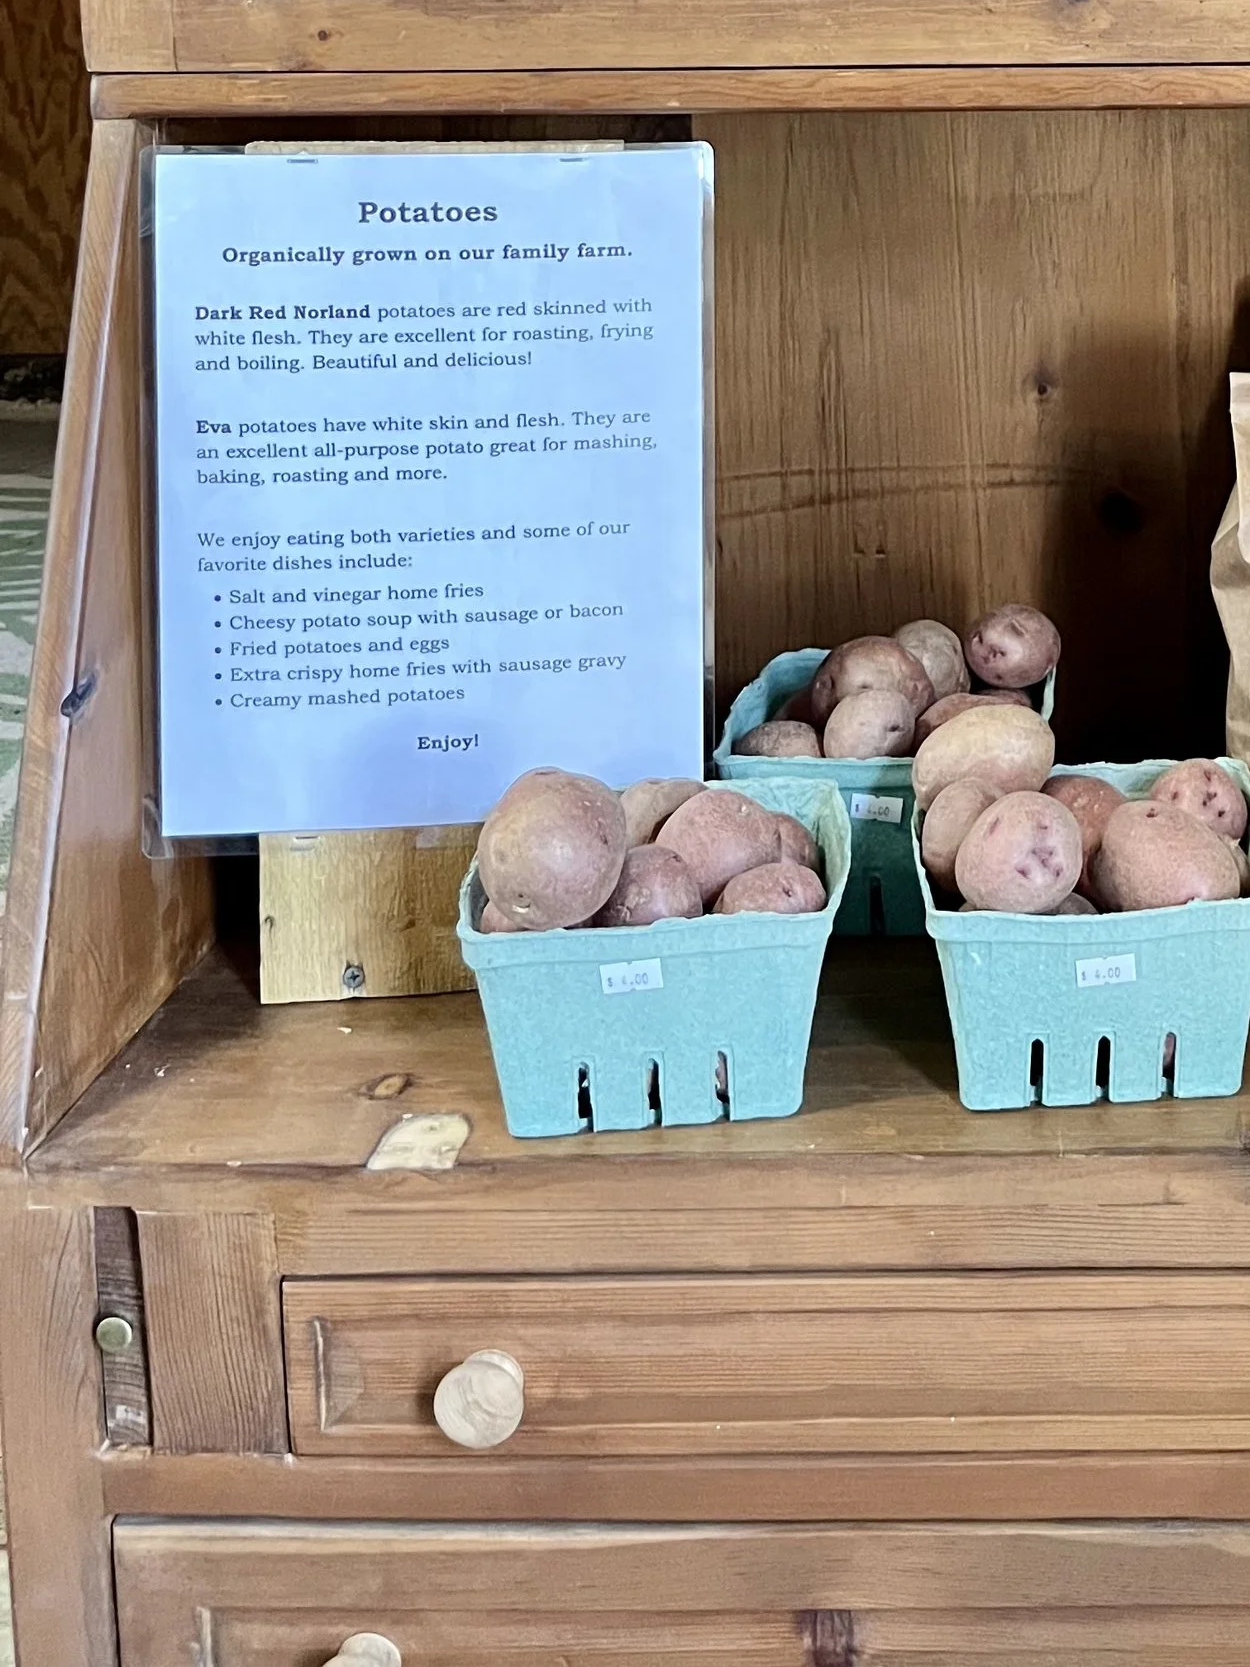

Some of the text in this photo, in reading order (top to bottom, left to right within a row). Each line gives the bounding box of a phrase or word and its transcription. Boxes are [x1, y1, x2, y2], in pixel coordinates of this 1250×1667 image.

[357, 201, 497, 223] Potatoes
[221, 242, 632, 266] Organically grown on our family farm.
[194, 297, 652, 322] Dark Red Norland potatoes are red skinned with
[194, 322, 653, 348] white flesh. They are excellent for roasting, frying
[195, 350, 531, 374] and boiling. Beautiful and delicious!
[195, 410, 650, 437] Eva potatoes have white skin and flesh. They are
[196, 433, 656, 461] an excellent all-purpose potato great for mashing,
[196, 465, 447, 487] baking, roasting and more.
[196, 520, 630, 550] We enjoy eating both varieties and some of our
[197, 552, 412, 572] favorite dishes include:
[229, 582, 483, 605] Salt and vinegar home fries
[229, 603, 623, 632] Cheesy potato soup with sausage or bacon
[229, 635, 449, 658] Fried potatoes and eggs
[230, 655, 626, 683] Extra crispy home fries with sausage gravy
[229, 688, 464, 710] Creamy mashed potatoes
[416, 733, 478, 752] Enjoy!
